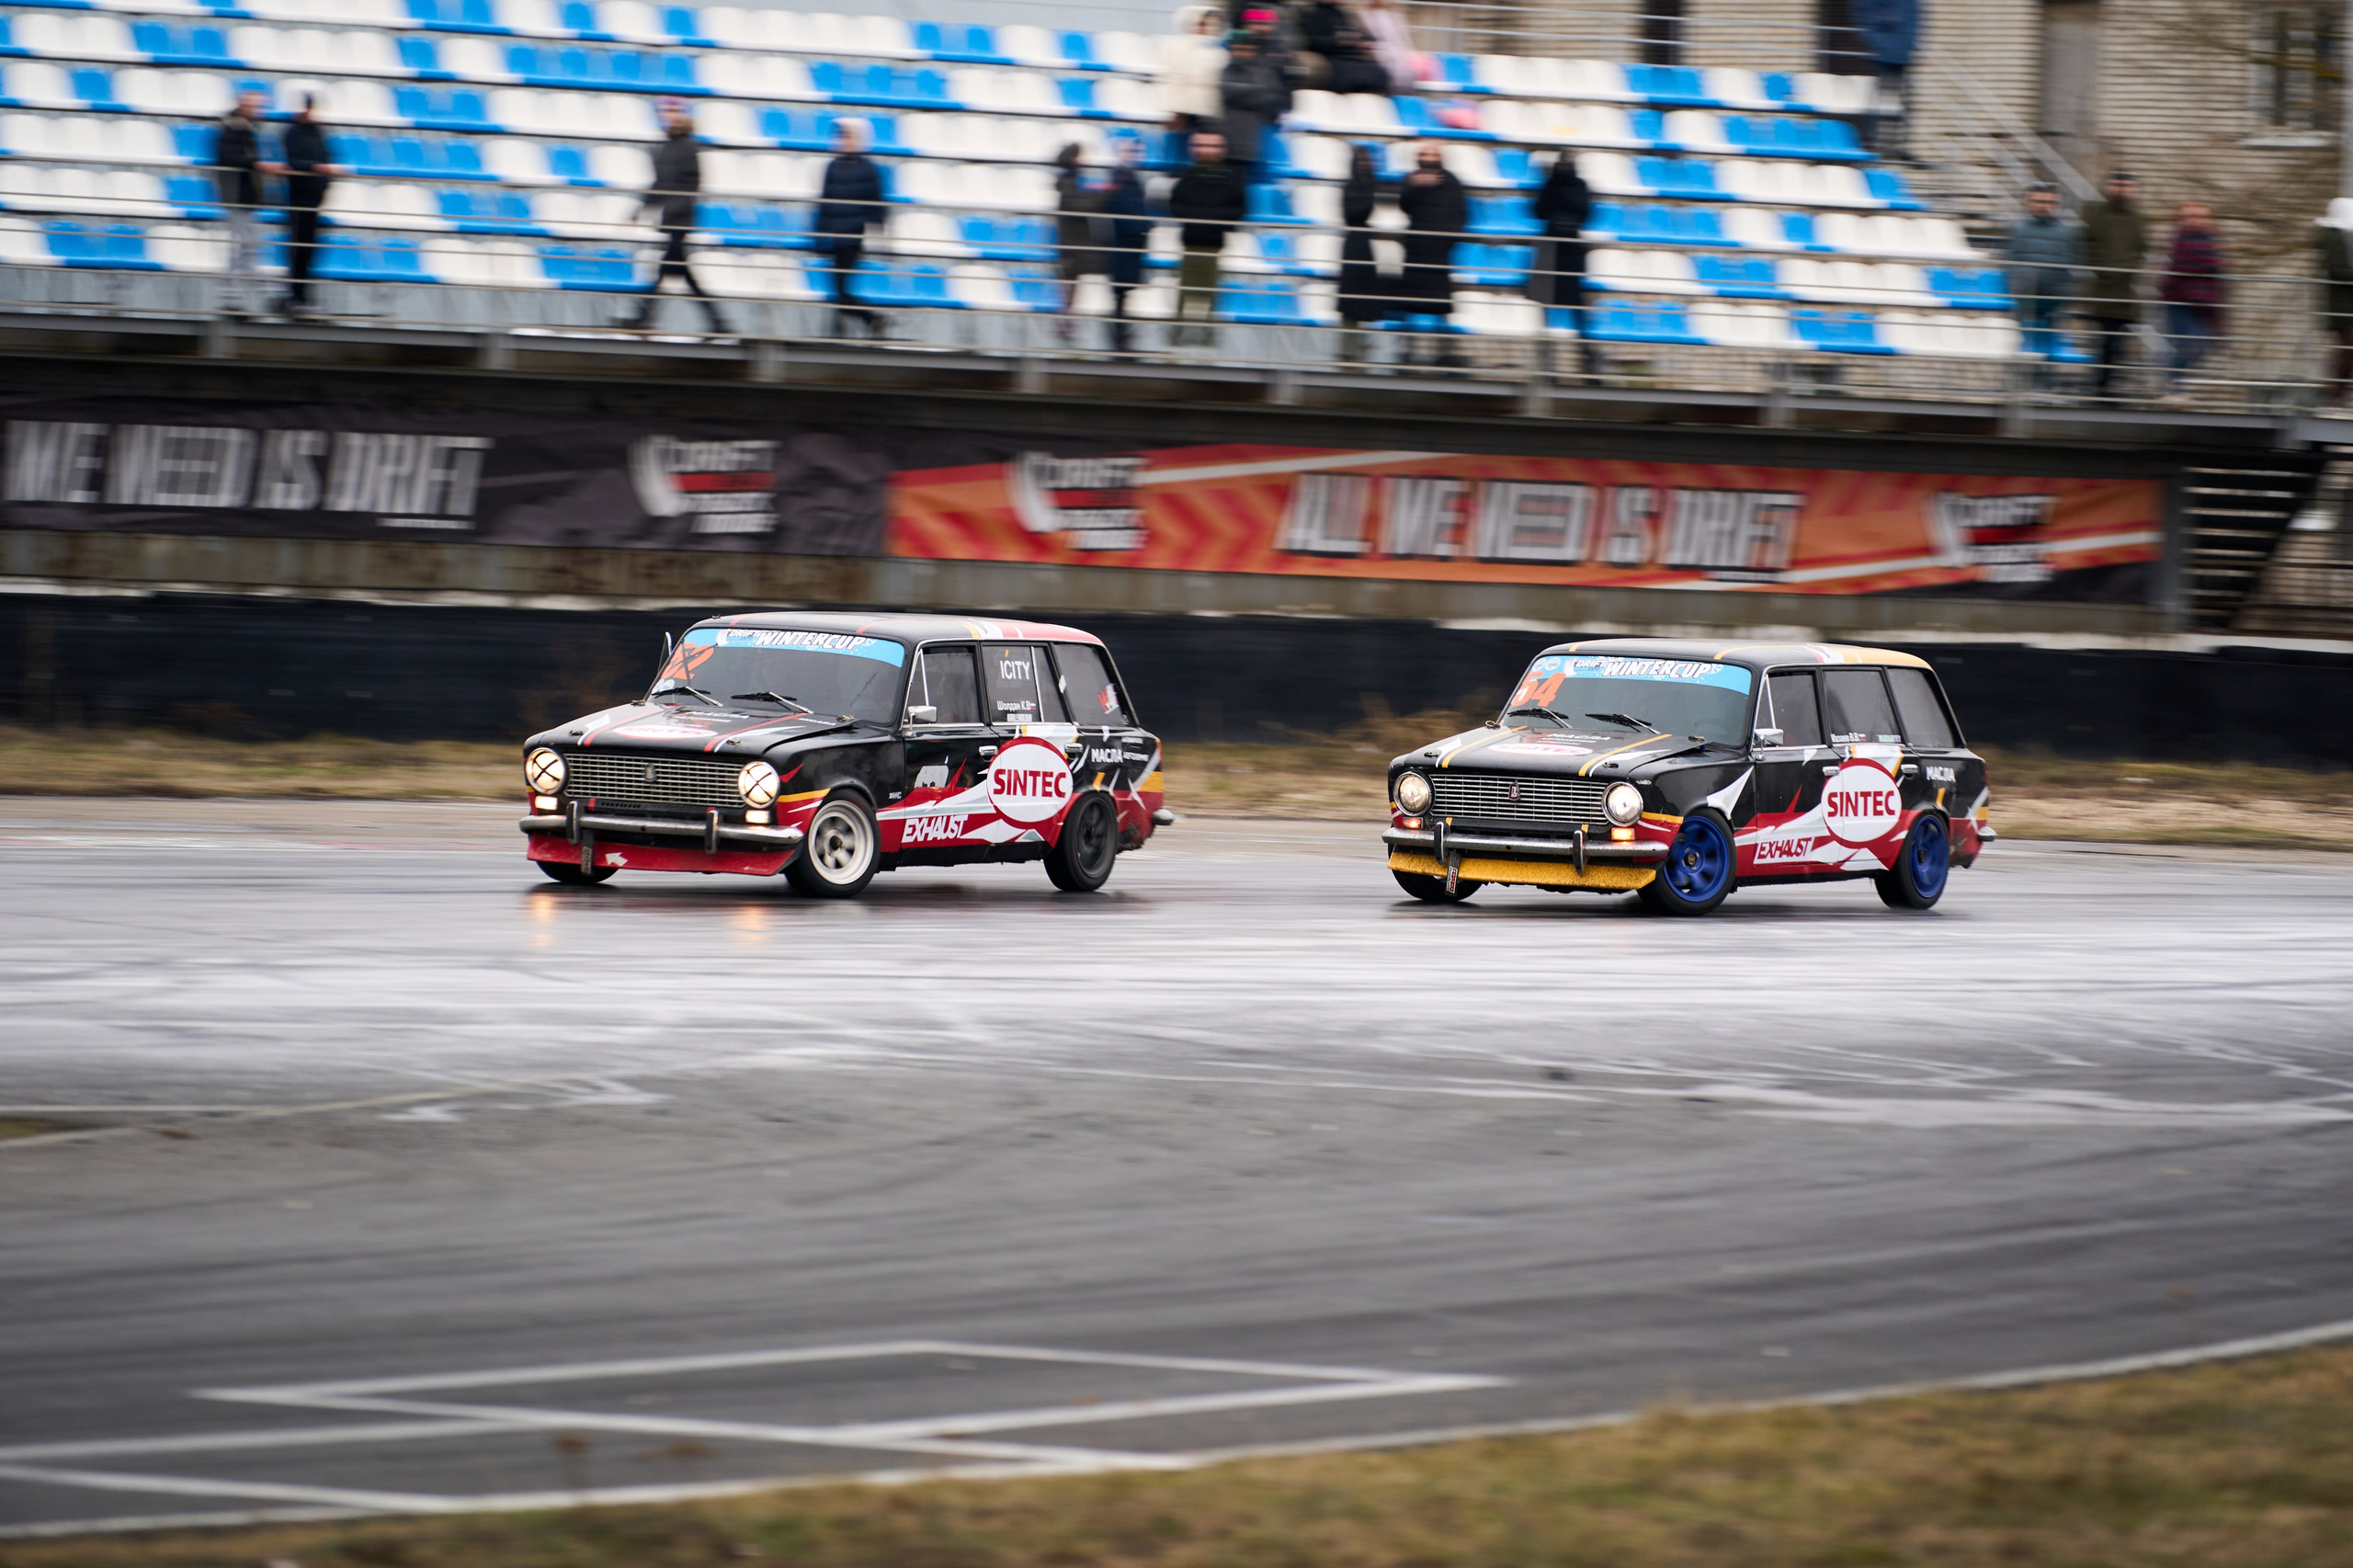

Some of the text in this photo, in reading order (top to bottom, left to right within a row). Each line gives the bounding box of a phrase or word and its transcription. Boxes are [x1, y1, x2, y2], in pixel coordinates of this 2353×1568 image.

[5, 420, 495, 516] WE NEED IS DRIFT
[1275, 473, 1806, 570] ALL WE NEED IS DRIFT
[729, 630, 760, 638] DRIFT
[999, 660, 1030, 680] ICITY
[1575, 659, 1606, 668] DRIFT
[1511, 671, 1566, 708] 54
[993, 768, 1066, 799] SINTEC
[1827, 790, 1895, 818] SINTEC
[901, 814, 969, 844] EXHAUST
[1756, 837, 1812, 859] EXHAUST
